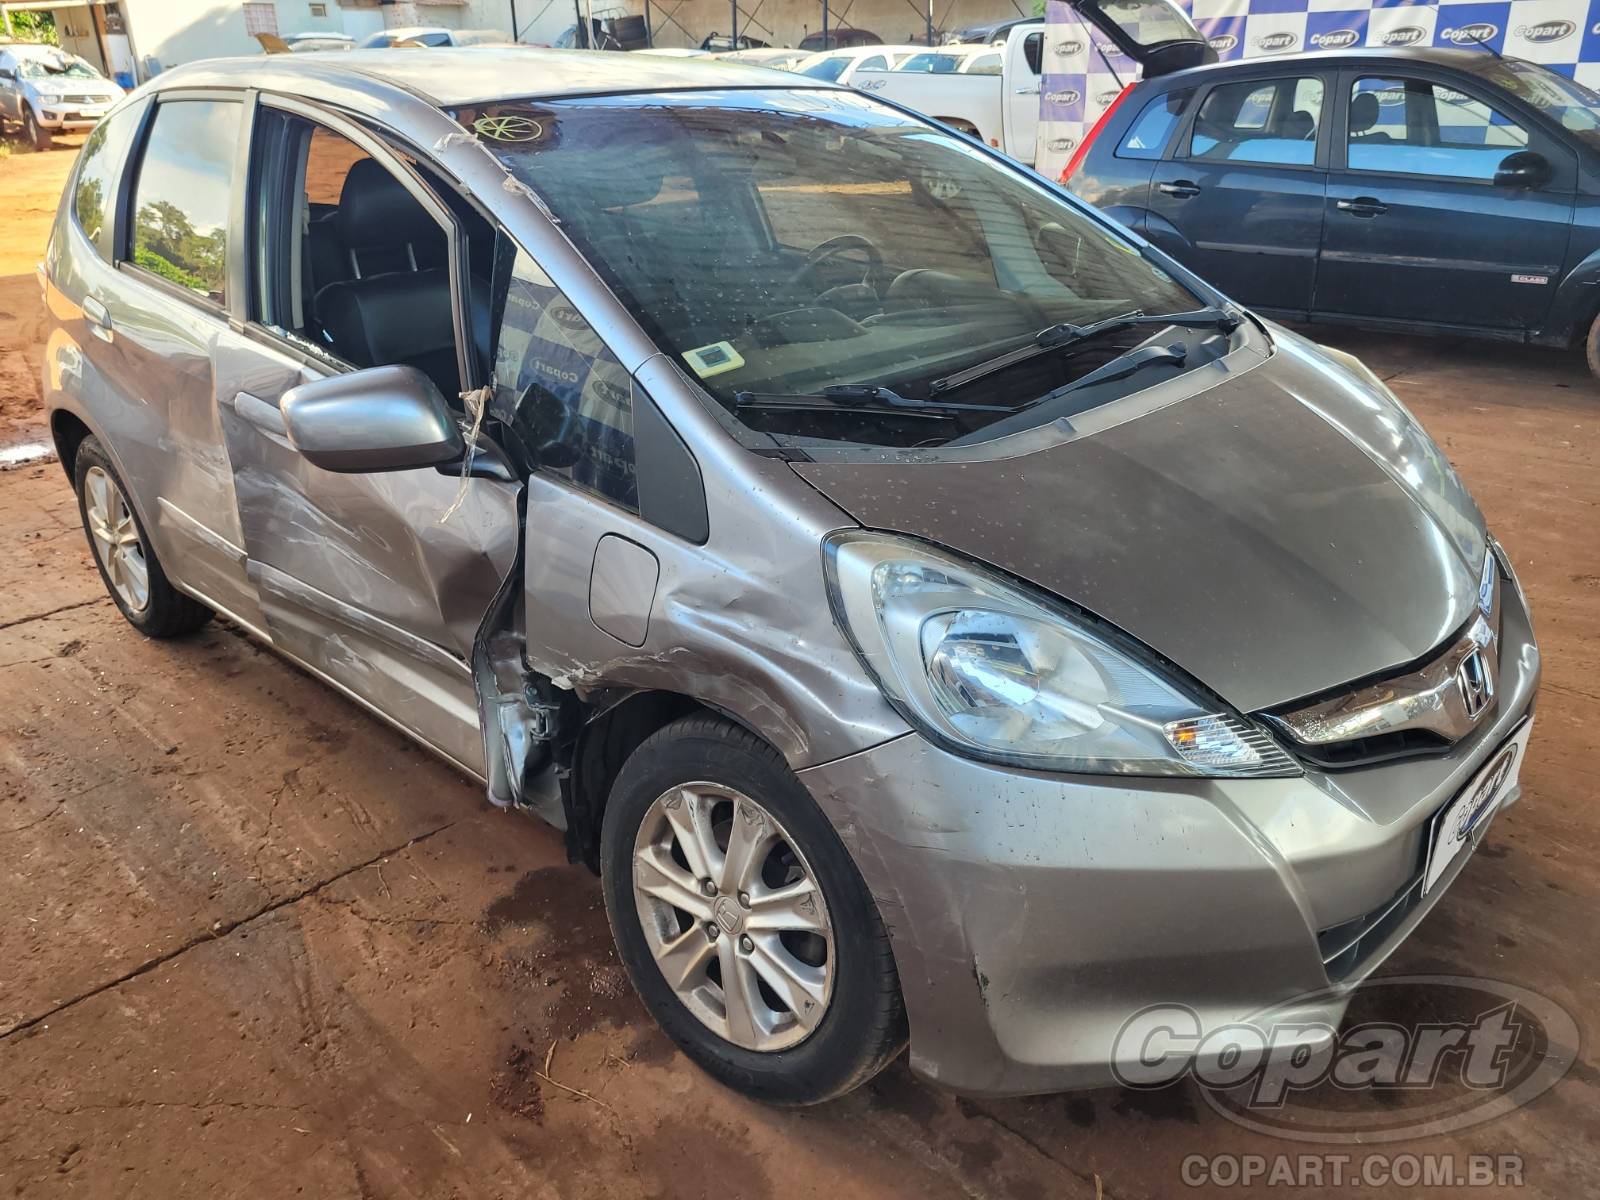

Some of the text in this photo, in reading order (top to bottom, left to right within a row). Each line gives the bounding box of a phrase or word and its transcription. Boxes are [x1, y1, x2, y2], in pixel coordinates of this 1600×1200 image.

[1310, 31, 1352, 46] Copart
[1441, 26, 1489, 41] Copart
[1514, 23, 1565, 41] Copart
[1045, 92, 1076, 104] Copart
